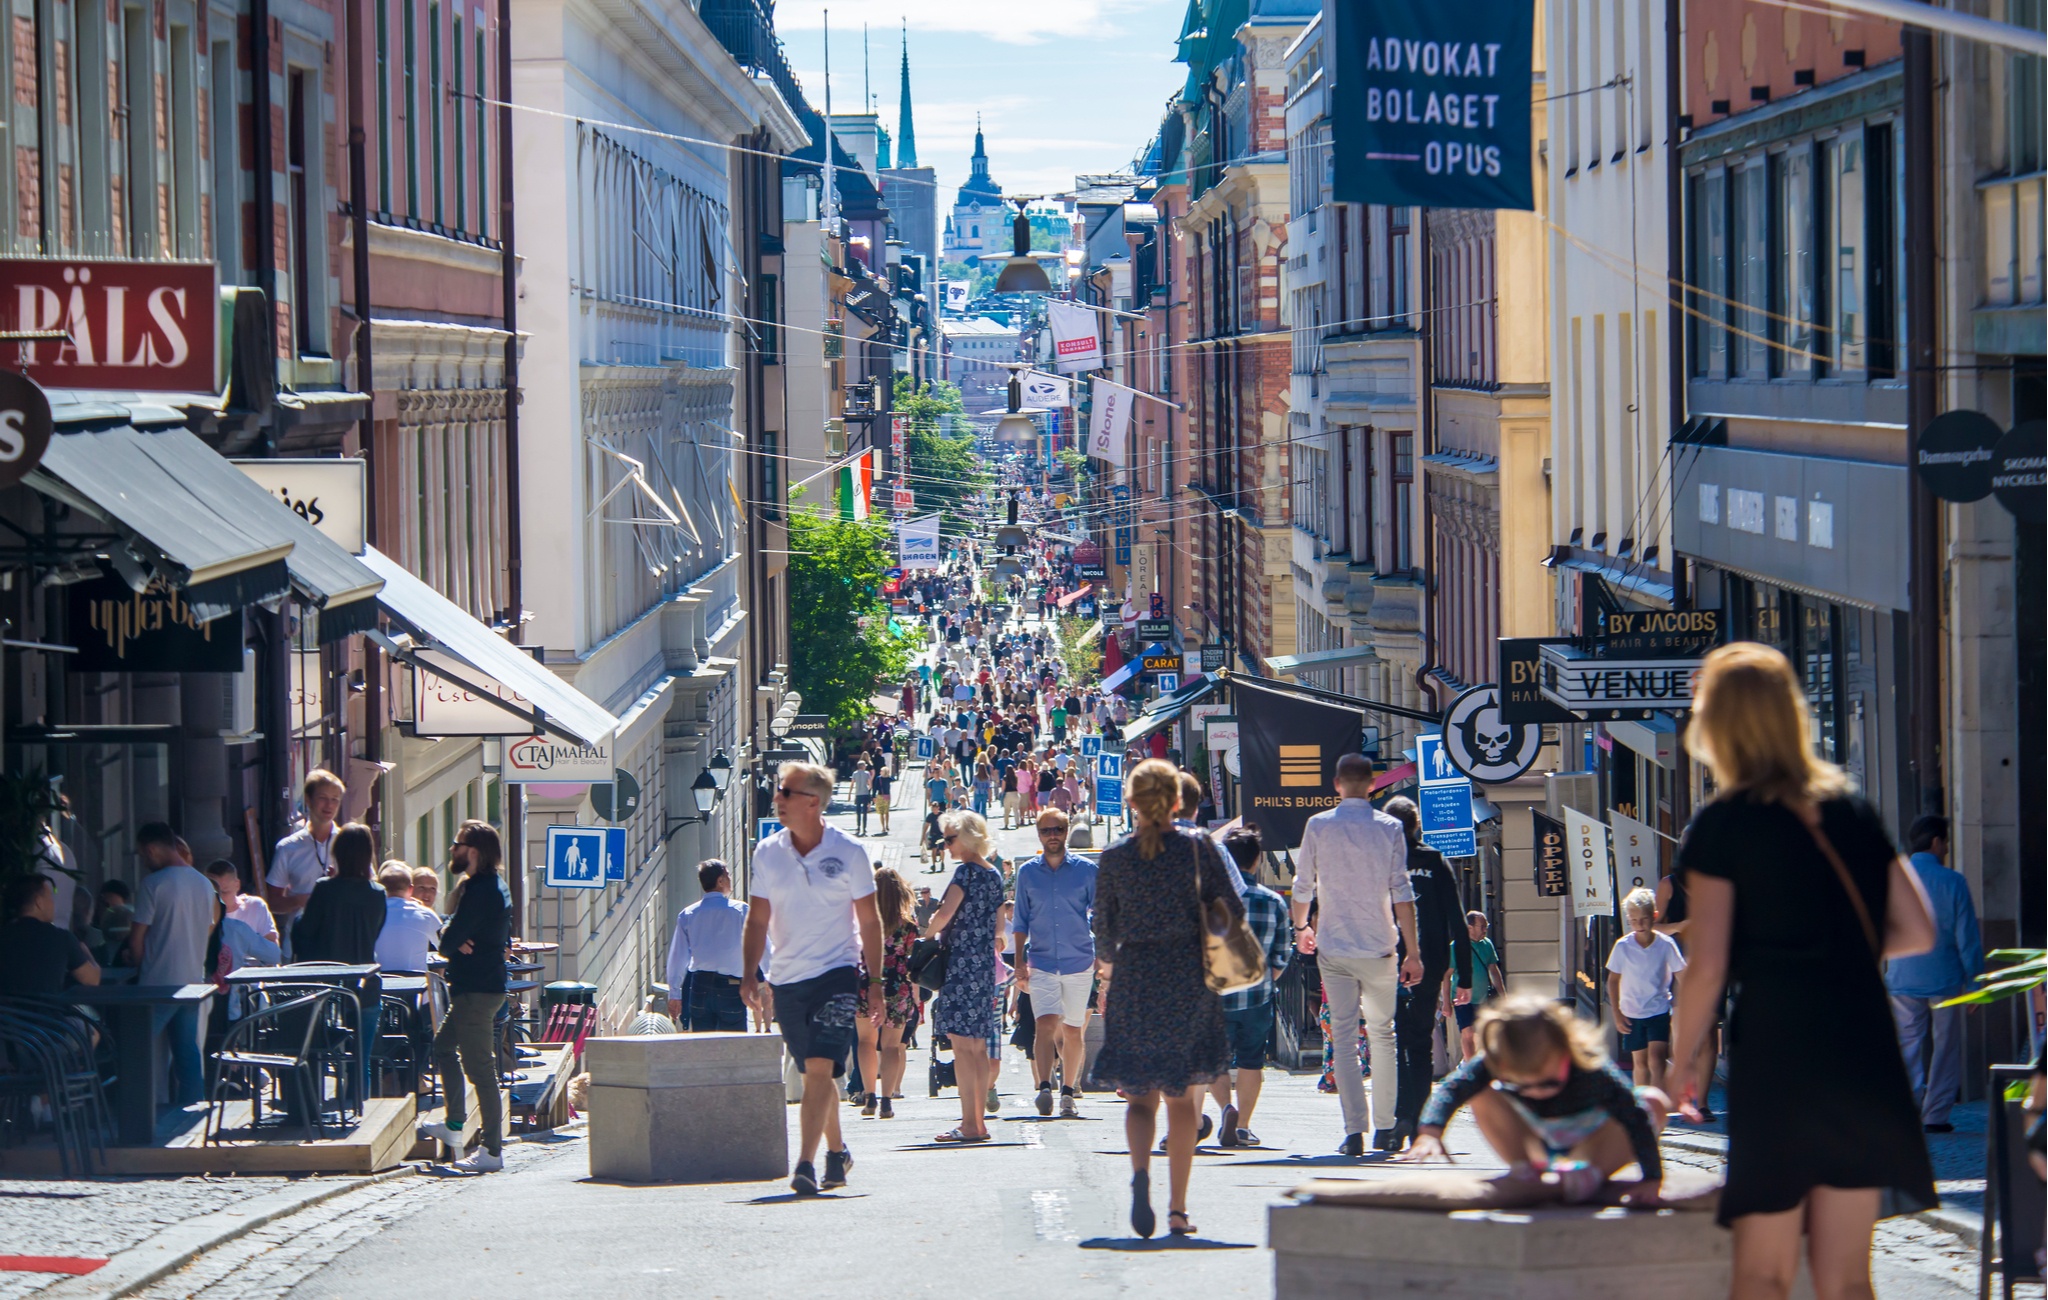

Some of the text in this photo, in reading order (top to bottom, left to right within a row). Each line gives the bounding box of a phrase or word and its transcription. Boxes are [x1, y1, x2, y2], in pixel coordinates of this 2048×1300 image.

[1366, 37, 1501, 78] ADVOKAT
[1366, 87, 1499, 129] BOLAGET
[1425, 141, 1501, 177] OPUS
[13, 266, 190, 368] PÄLS
[1060, 338, 1094, 348] KONSULT
[1026, 394, 1062, 403] AUDERE
[1117, 500, 1129, 561] HOTEL
[902, 553, 937, 561] SKAGEN
[1609, 611, 1717, 634] BY JACOBS
[1650, 638, 1658, 647] &
[1144, 658, 1180, 669] CARAT
[1511, 660, 1540, 684] BY
[518, 745, 608, 770] TAJ MAHAL
[580, 759, 608, 767] Beauty
[1254, 796, 1342, 808] PHIL'S BURGE
[1543, 832, 1565, 894] ÖPPET
